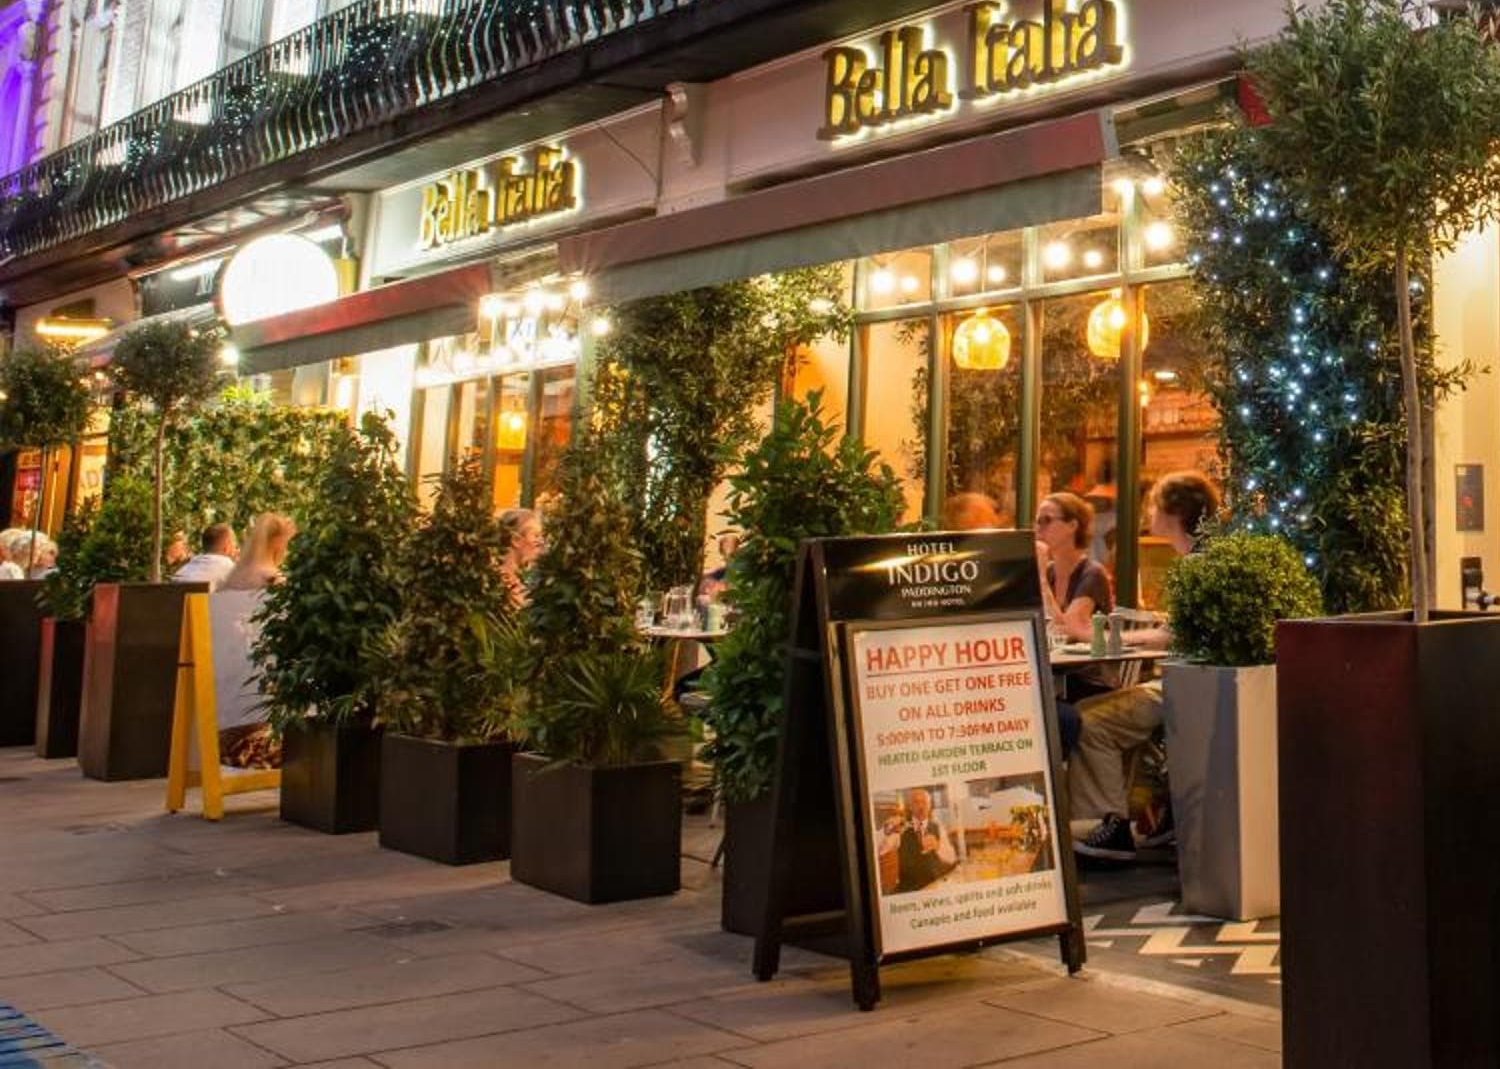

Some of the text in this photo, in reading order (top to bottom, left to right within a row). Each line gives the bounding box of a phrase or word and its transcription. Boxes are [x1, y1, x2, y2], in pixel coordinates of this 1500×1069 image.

[817, 26, 953, 141] Bella
[420, 145, 577, 250] Bella Italia
[907, 542, 958, 556] HOTEL
[886, 560, 978, 586] INDIGO
[901, 584, 972, 599] PADDINGTON
[866, 637, 1026, 672] HAPPY HOUR
[867, 672, 1032, 700] BUY ONE GET ONE FREE
[899, 698, 1006, 722] ON ALL DRINKS
[928, 727, 946, 741] TO
[997, 718, 1030, 733] DAILY
[878, 738, 1034, 767] HEATED GARDEN TERRACE ON
[951, 759, 988, 774] FLOOR
[953, 907, 972, 922] and
